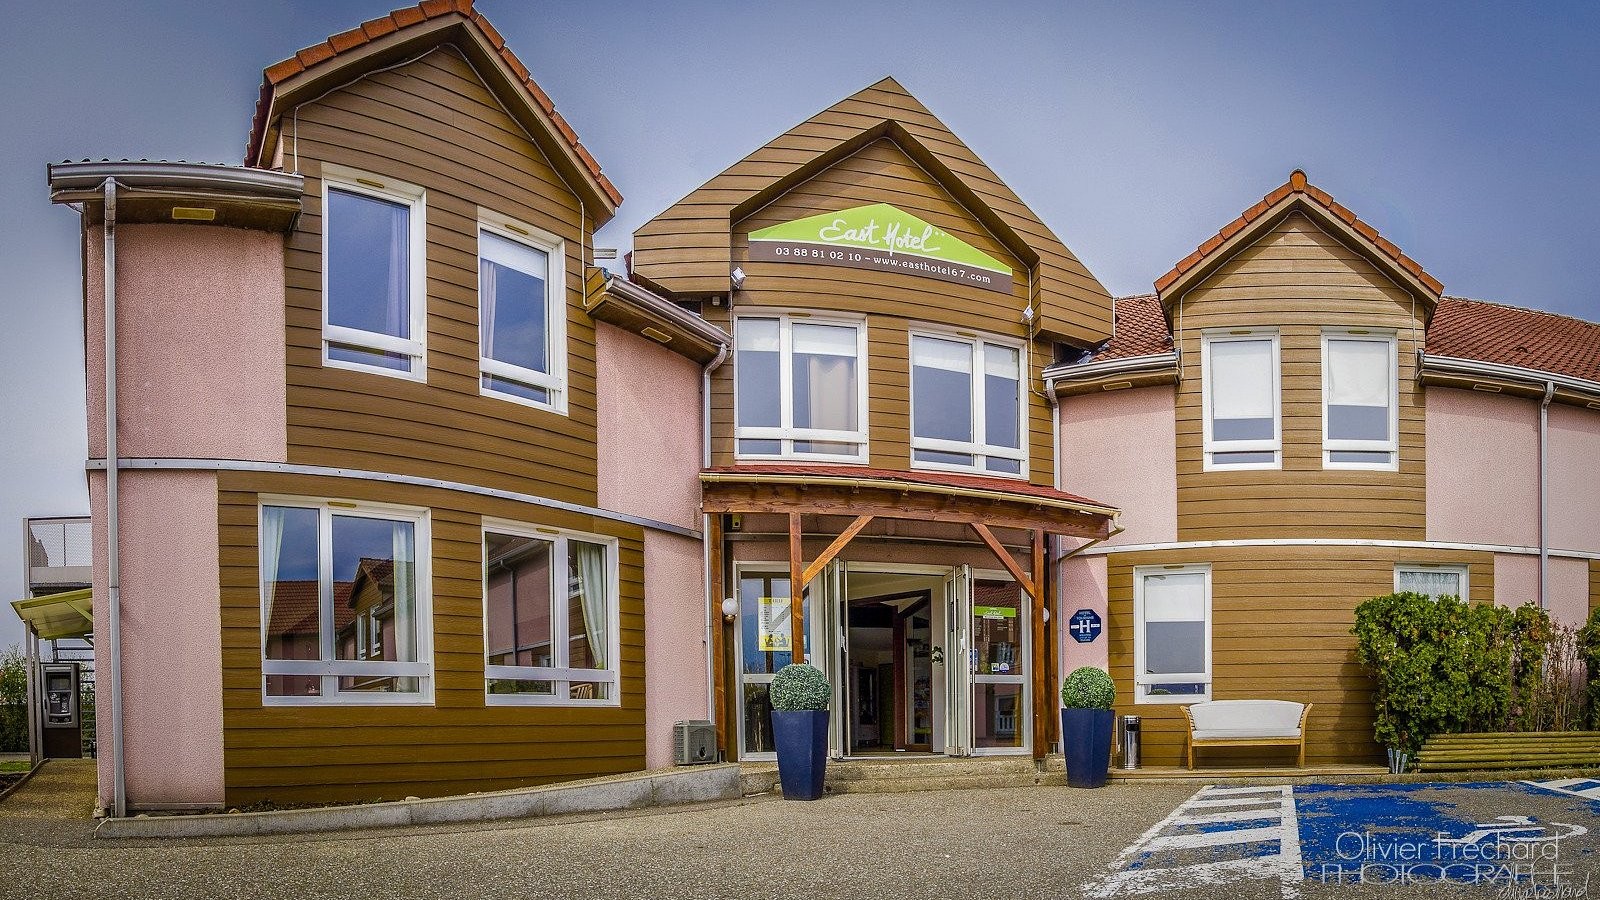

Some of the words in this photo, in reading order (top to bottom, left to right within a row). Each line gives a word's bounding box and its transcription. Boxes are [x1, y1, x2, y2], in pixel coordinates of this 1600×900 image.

[819, 219, 879, 244] East
[882, 221, 941, 257] Hotel
[775, 247, 790, 256] 03
[793, 248, 808, 257] 88
[811, 249, 825, 259] 81
[829, 251, 844, 260] 02
[848, 253, 862, 262] 10
[873, 257, 991, 284] www.easthotel67.com
[1079, 619, 1091, 634] H
